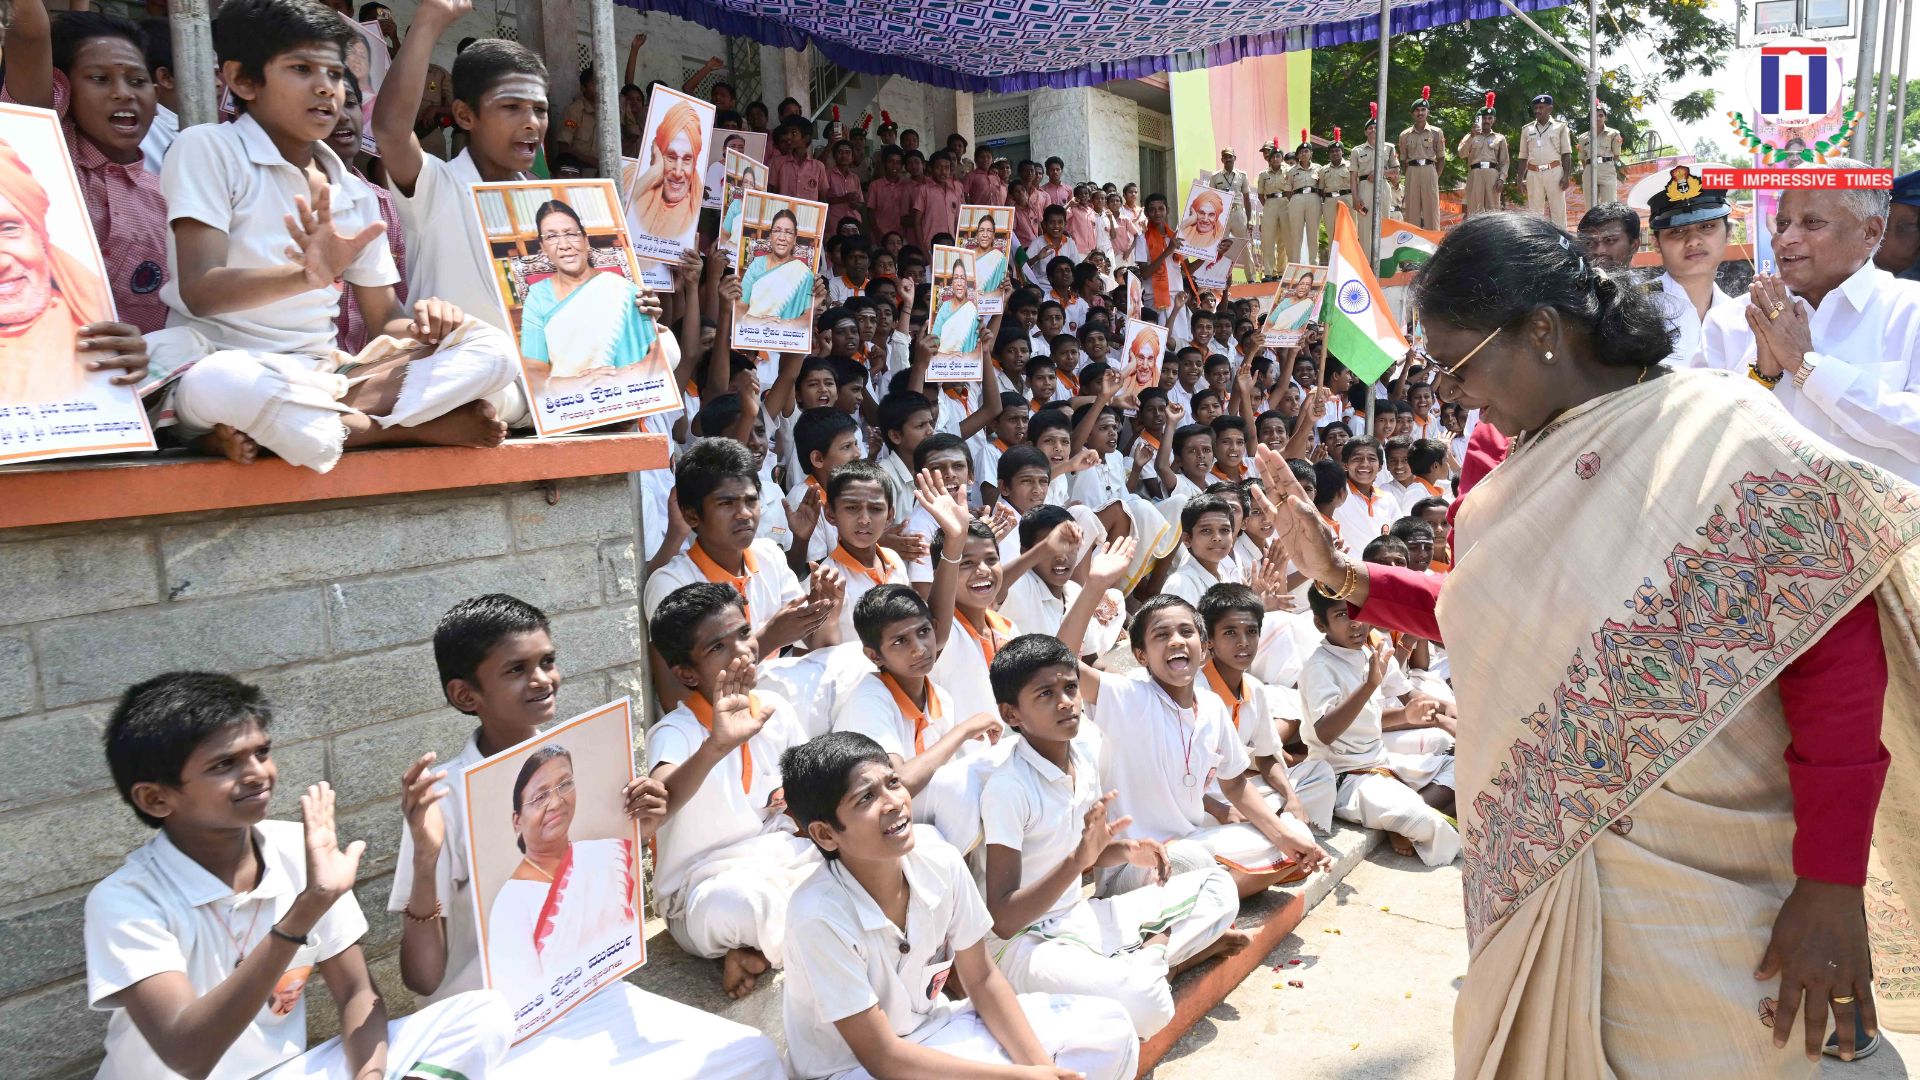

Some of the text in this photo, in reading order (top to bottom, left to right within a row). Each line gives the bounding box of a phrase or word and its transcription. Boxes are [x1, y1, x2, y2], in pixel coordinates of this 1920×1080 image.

[545, 379, 664, 413] ಶ್ರೀಮತಿ ದ್ರೌಪದಿ ಮುರ್ಮು
[551, 966, 583, 997] ದ್ರೌಪದಿ
[588, 935, 633, 969] ಮುರ್ಮು
